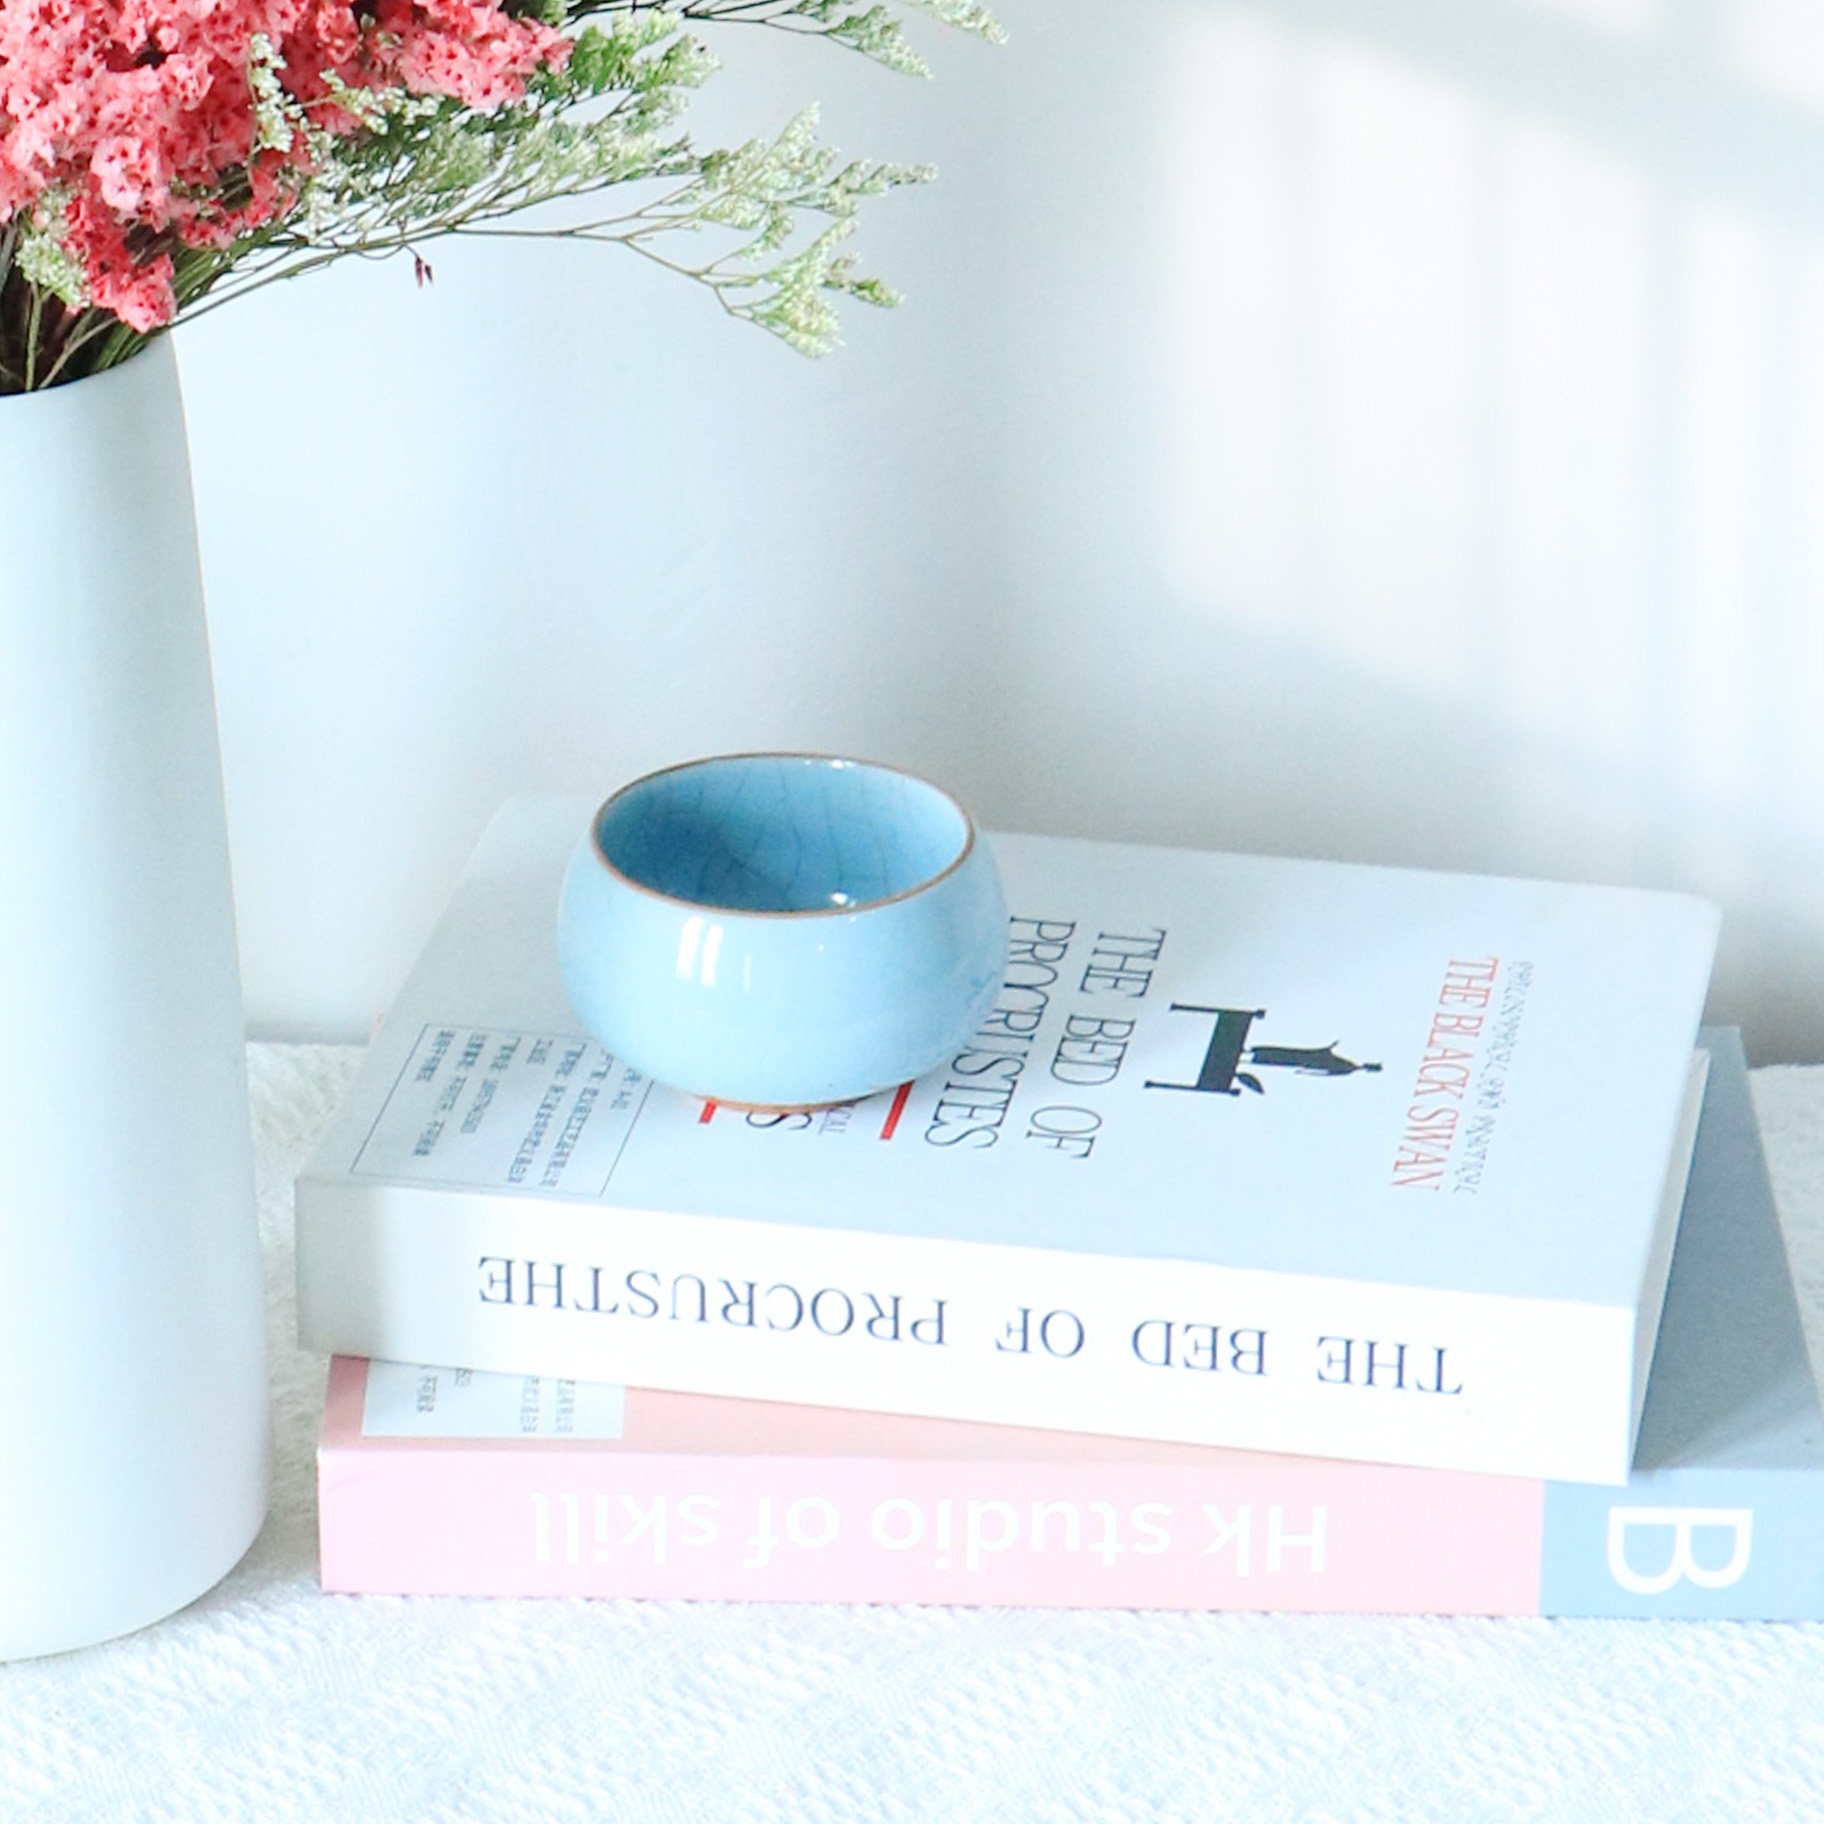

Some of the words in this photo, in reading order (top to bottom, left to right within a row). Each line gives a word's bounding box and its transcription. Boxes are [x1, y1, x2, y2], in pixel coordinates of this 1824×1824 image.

[1080, 927, 1166, 998] THE
[1439, 957, 1498, 1008] THE
[1050, 1014, 1136, 1086] BED
[1413, 1011, 1484, 1100] BLACK
[1025, 1105, 1103, 1159] OF
[1390, 1106, 1460, 1191] SWAN
[477, 1255, 949, 1346] PROCRUSTHE
[995, 1306, 1085, 1358] OF
[1131, 1318, 1269, 1376] BED
[1316, 1335, 1463, 1395] THE
[529, 1490, 719, 1567] skill
[742, 1494, 843, 1570] of
[869, 1495, 1174, 1573] studio
[1201, 1504, 1329, 1577] Hk
[1606, 1505, 1754, 1595] B
